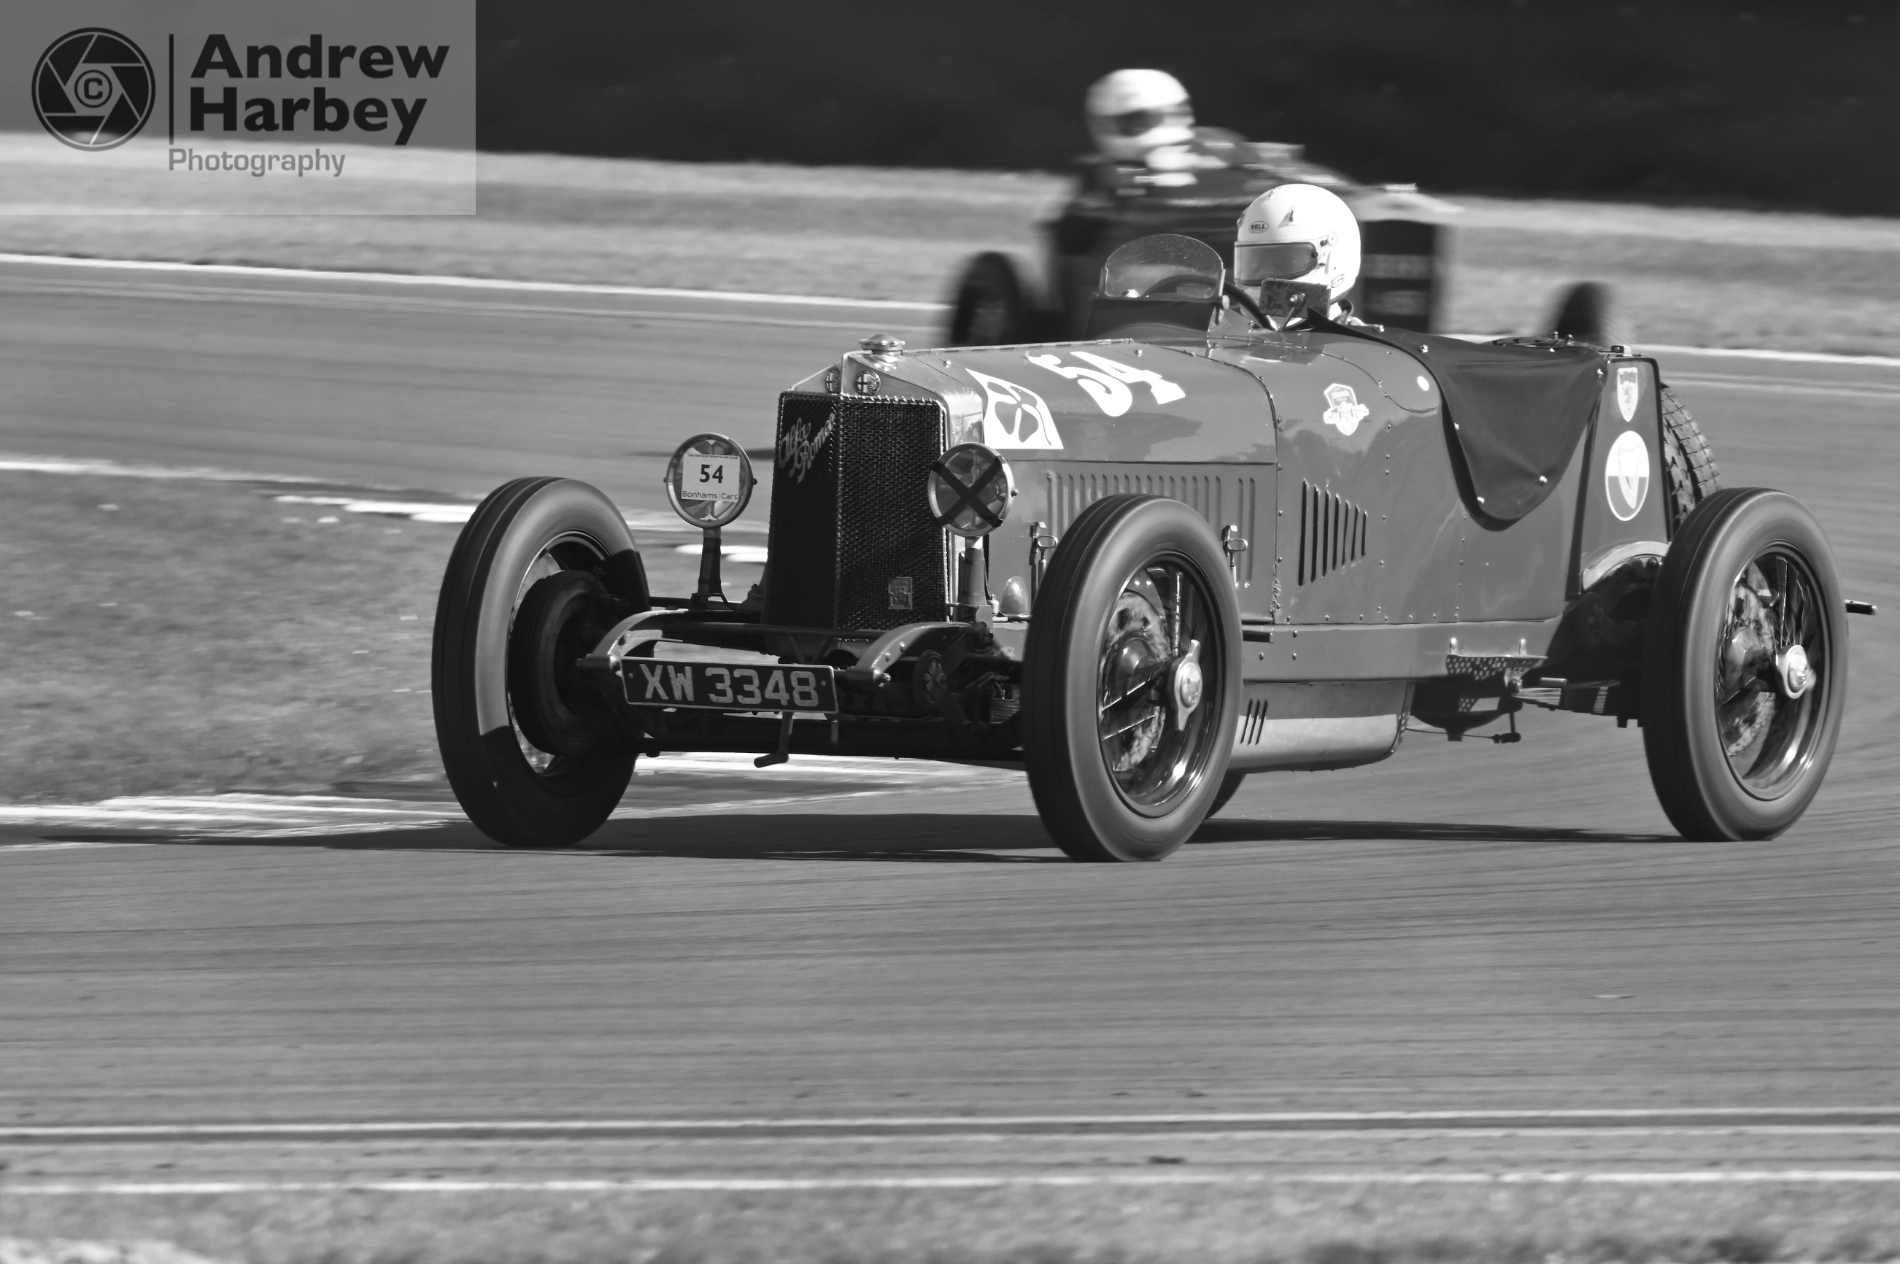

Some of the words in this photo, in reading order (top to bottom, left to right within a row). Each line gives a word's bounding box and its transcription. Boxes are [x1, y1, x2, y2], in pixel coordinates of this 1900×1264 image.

[1027, 351, 1186, 417] 54
[699, 464, 724, 484] 54
[682, 490, 718, 499] Bonhams
[720, 492, 738, 500] Cars
[639, 663, 695, 701] XW
[705, 667, 819, 707] 3348
